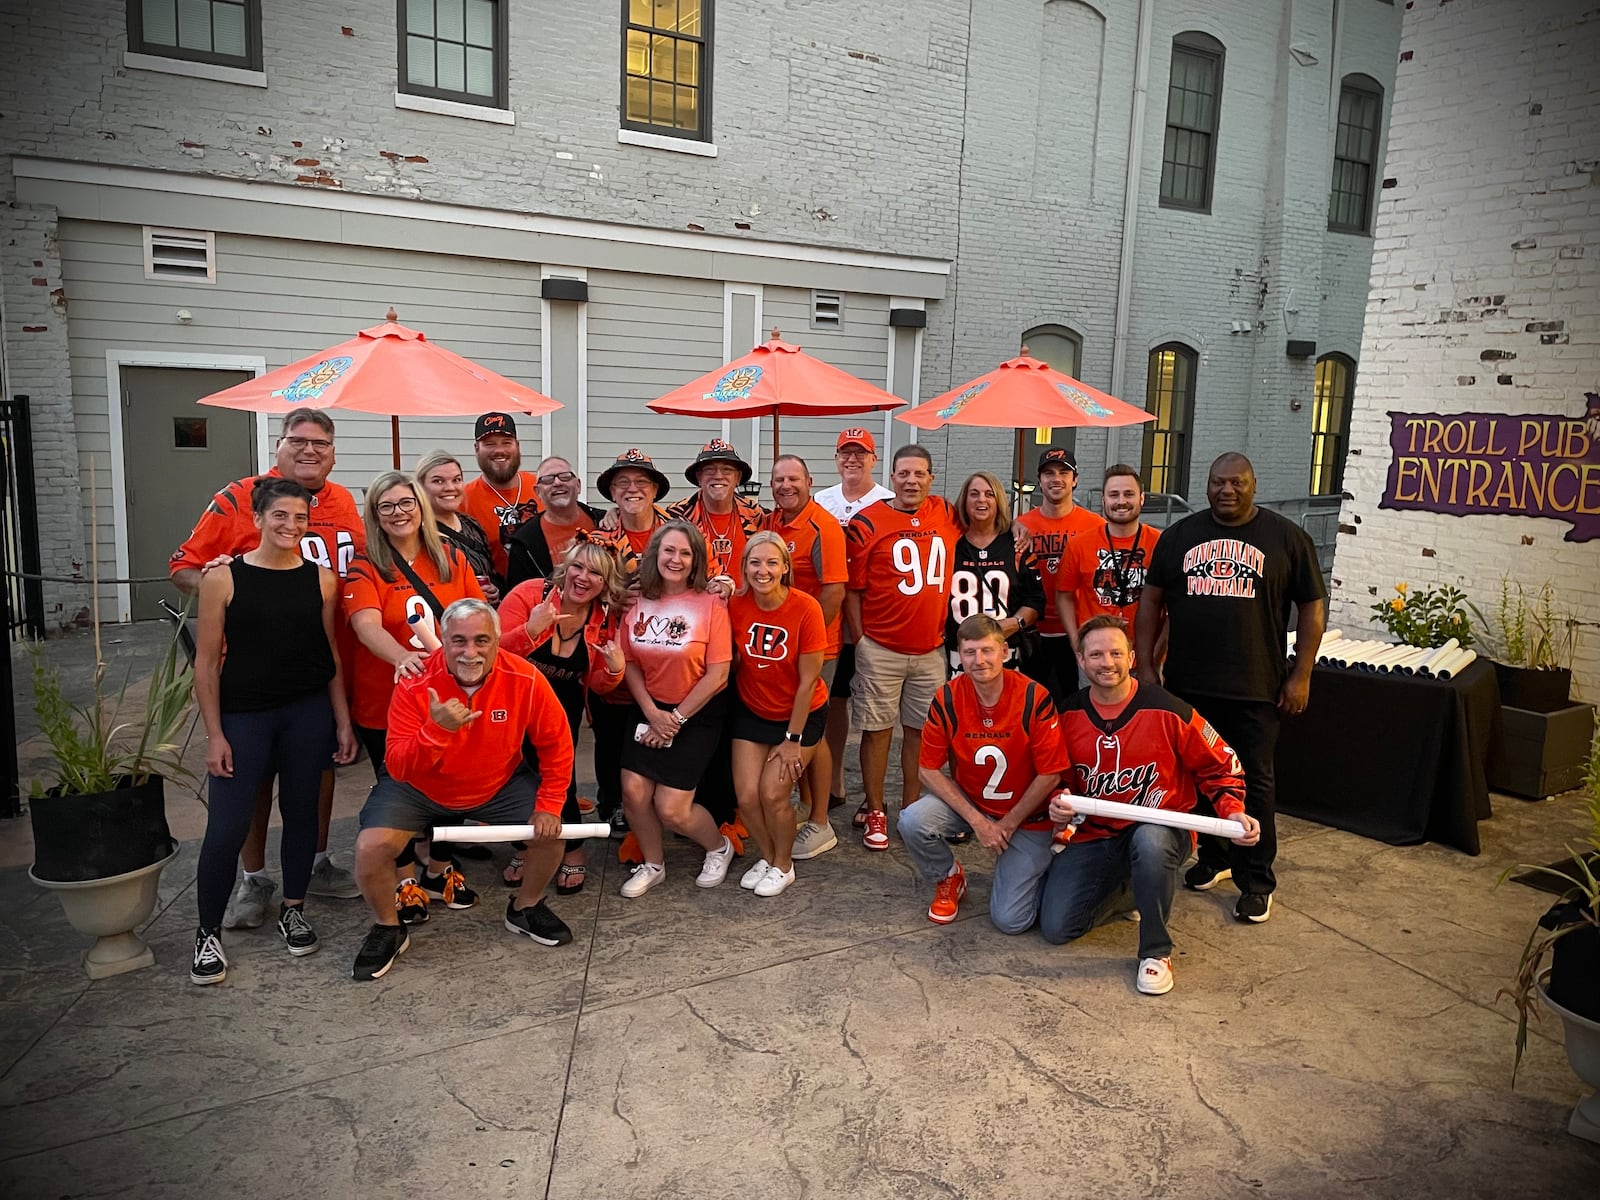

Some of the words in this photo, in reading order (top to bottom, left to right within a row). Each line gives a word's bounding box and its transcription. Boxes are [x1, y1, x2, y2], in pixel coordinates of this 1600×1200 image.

[1405, 419, 1507, 455] TROLL
[1518, 420, 1590, 458] PUB
[1395, 456, 1600, 515] ENTRANCE
[893, 536, 947, 596] 94
[1183, 538, 1265, 578] CINCINNATI
[951, 570, 1010, 625] 80
[1187, 575, 1256, 598] FOOTBALL
[974, 744, 1014, 800] 2
